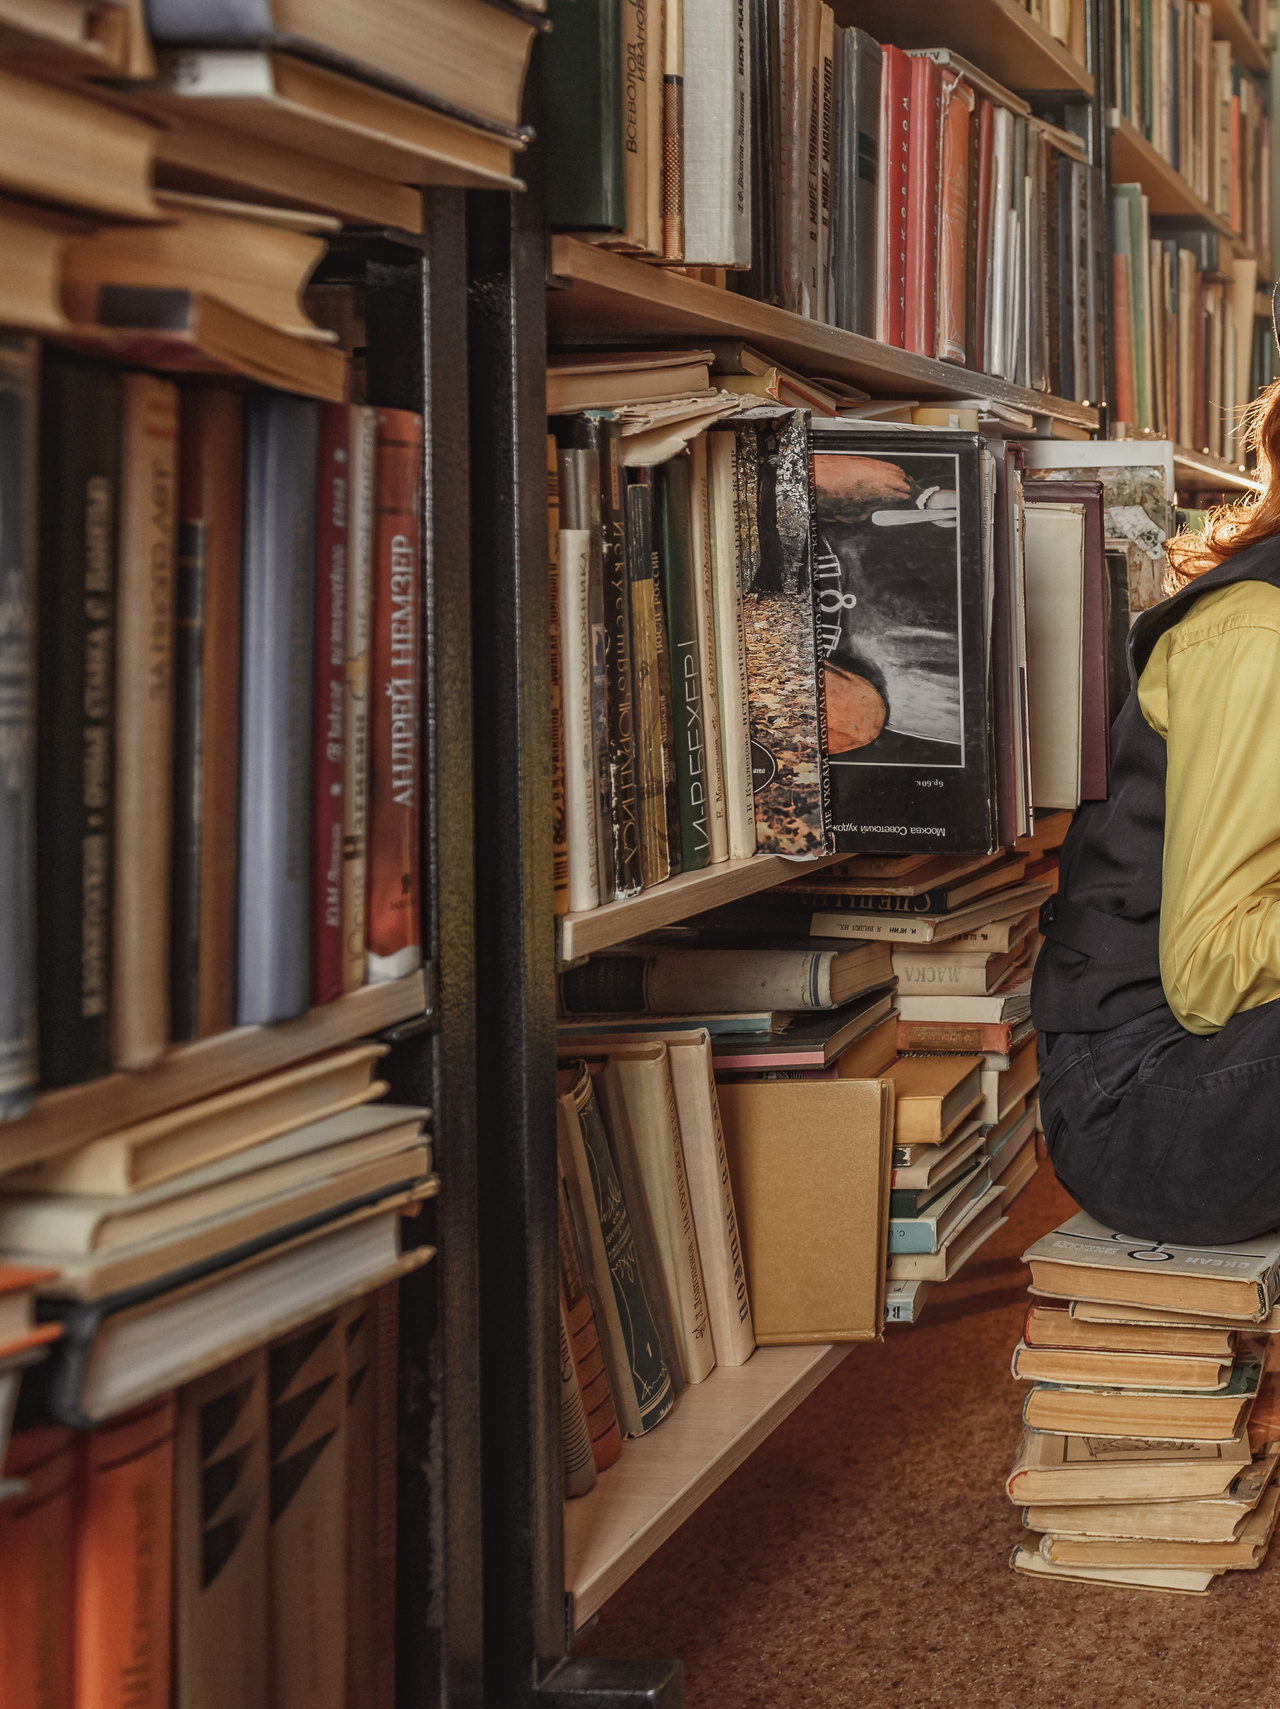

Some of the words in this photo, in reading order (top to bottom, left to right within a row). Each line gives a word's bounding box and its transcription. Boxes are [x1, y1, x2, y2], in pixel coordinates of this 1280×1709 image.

[626, 42, 638, 154] ВСЕВОЛОД
[822, 56, 832, 163] МАЯКОВСКОГО
[808, 180, 818, 226] МИРЕ
[821, 167, 830, 211] МИРЕ
[390, 533, 415, 665] НЕМЗЕР
[651, 550, 661, 605] РОССИИ
[580, 549, 589, 687] ХУДОЖНИКА
[581, 695, 591, 740] МИР
[385, 676, 415, 807] АНДРЕЙ
[859, 824, 908, 836] Советский
[910, 826, 946, 837] Москва
[888, 926, 907, 934] ИГИН
[909, 927, 917, 935] И.
[903, 966, 961, 983] МАСКА
[725, 1208, 749, 1325] поэты
[1183, 1255, 1251, 1270] ОКЕАН
